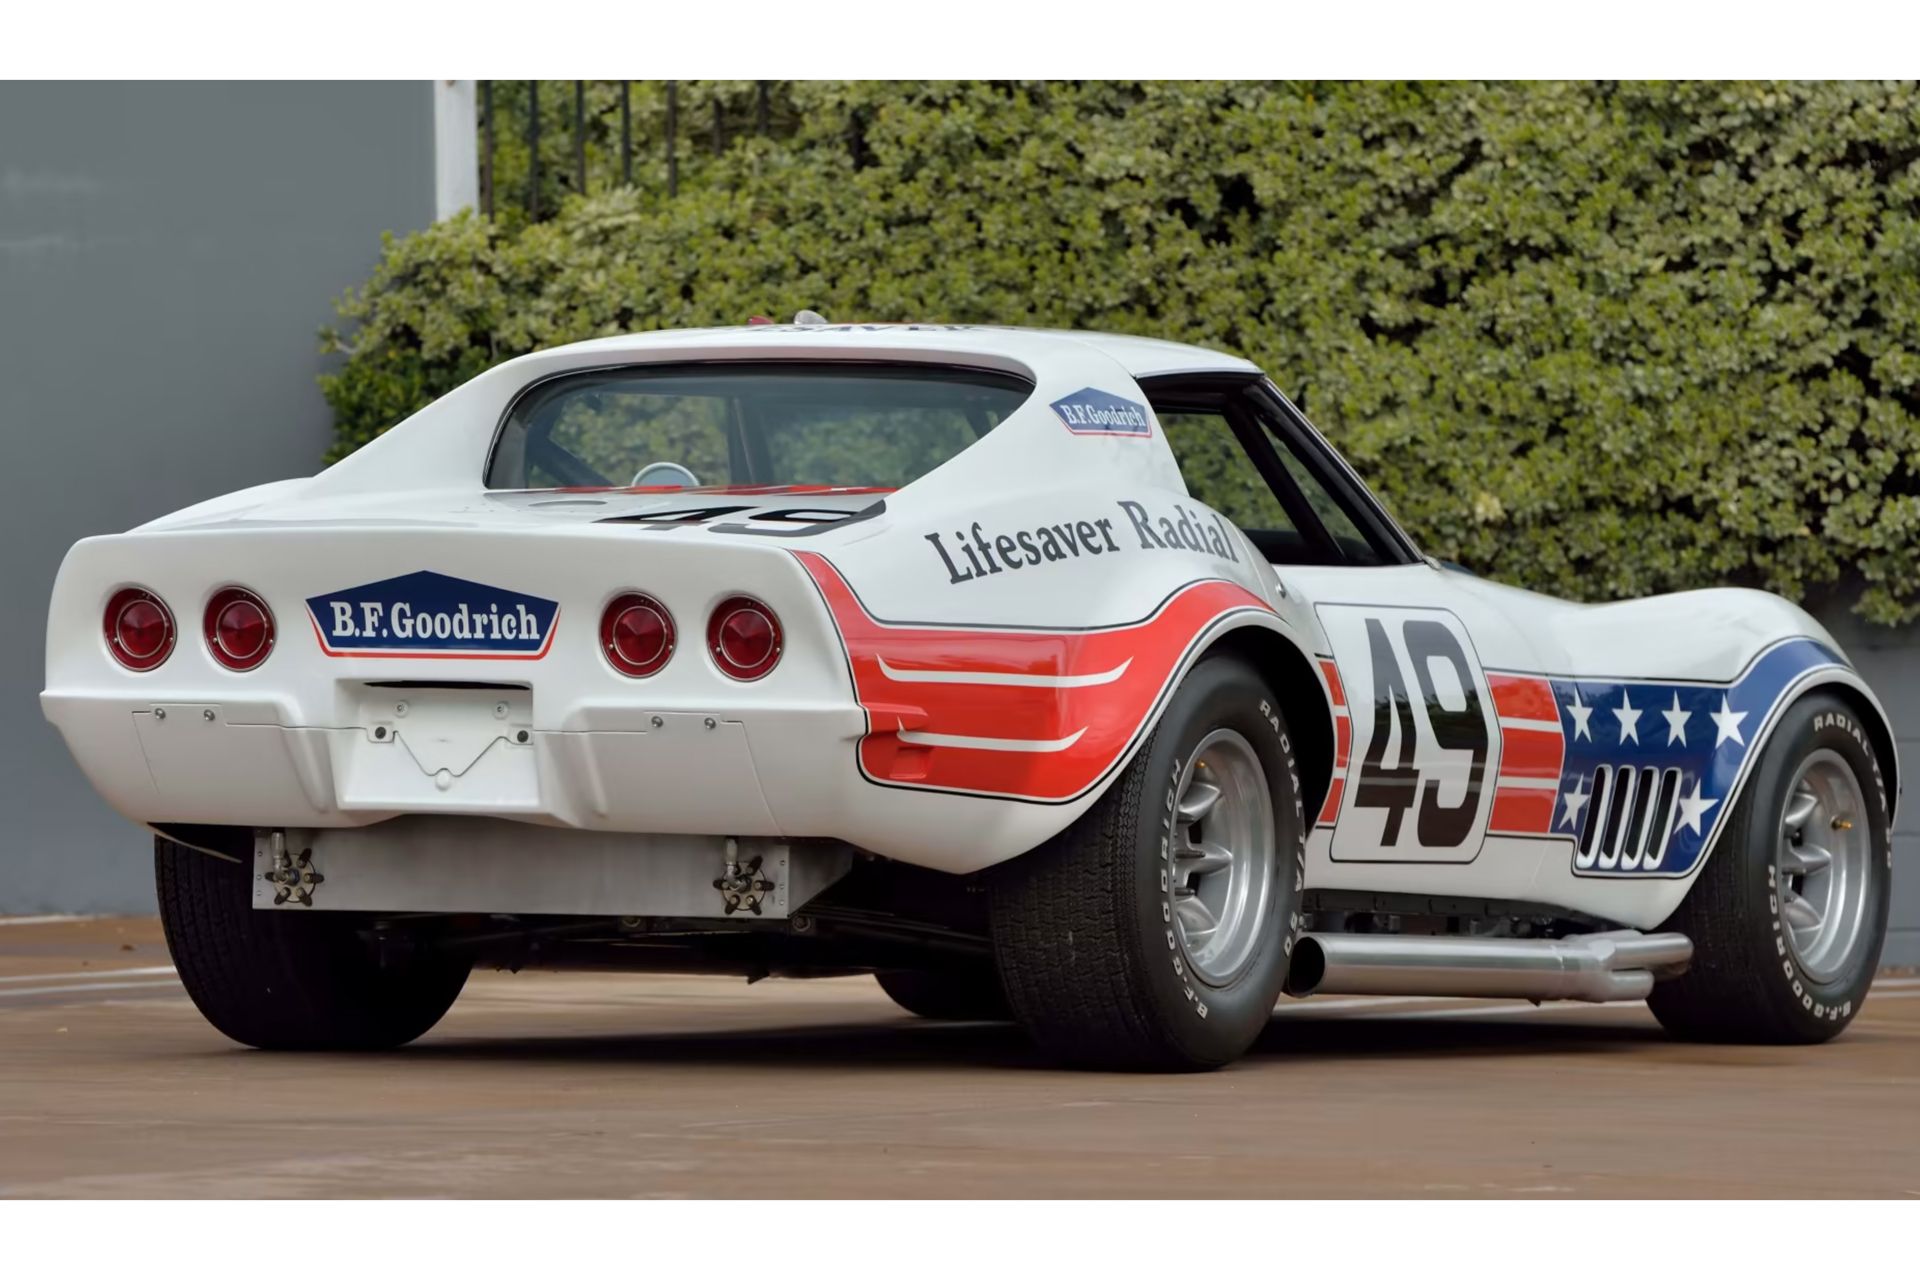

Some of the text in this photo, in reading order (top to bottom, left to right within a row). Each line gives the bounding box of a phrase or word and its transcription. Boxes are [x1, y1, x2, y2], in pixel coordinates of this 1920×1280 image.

[1060, 404, 1146, 427] B.F.Goodrich
[590, 498, 887, 538] 49
[924, 500, 1240, 585] Lifesaver Radial
[329, 601, 541, 640] B.F.Goodrich
[1259, 699, 1302, 818] RADIAL
[1354, 618, 1489, 847] 49
[1813, 712, 1870, 757] RADIAL
[1160, 758, 1209, 1019] B.F.GOODRICH
[1767, 864, 1853, 1021] B.F.GOODRICH
